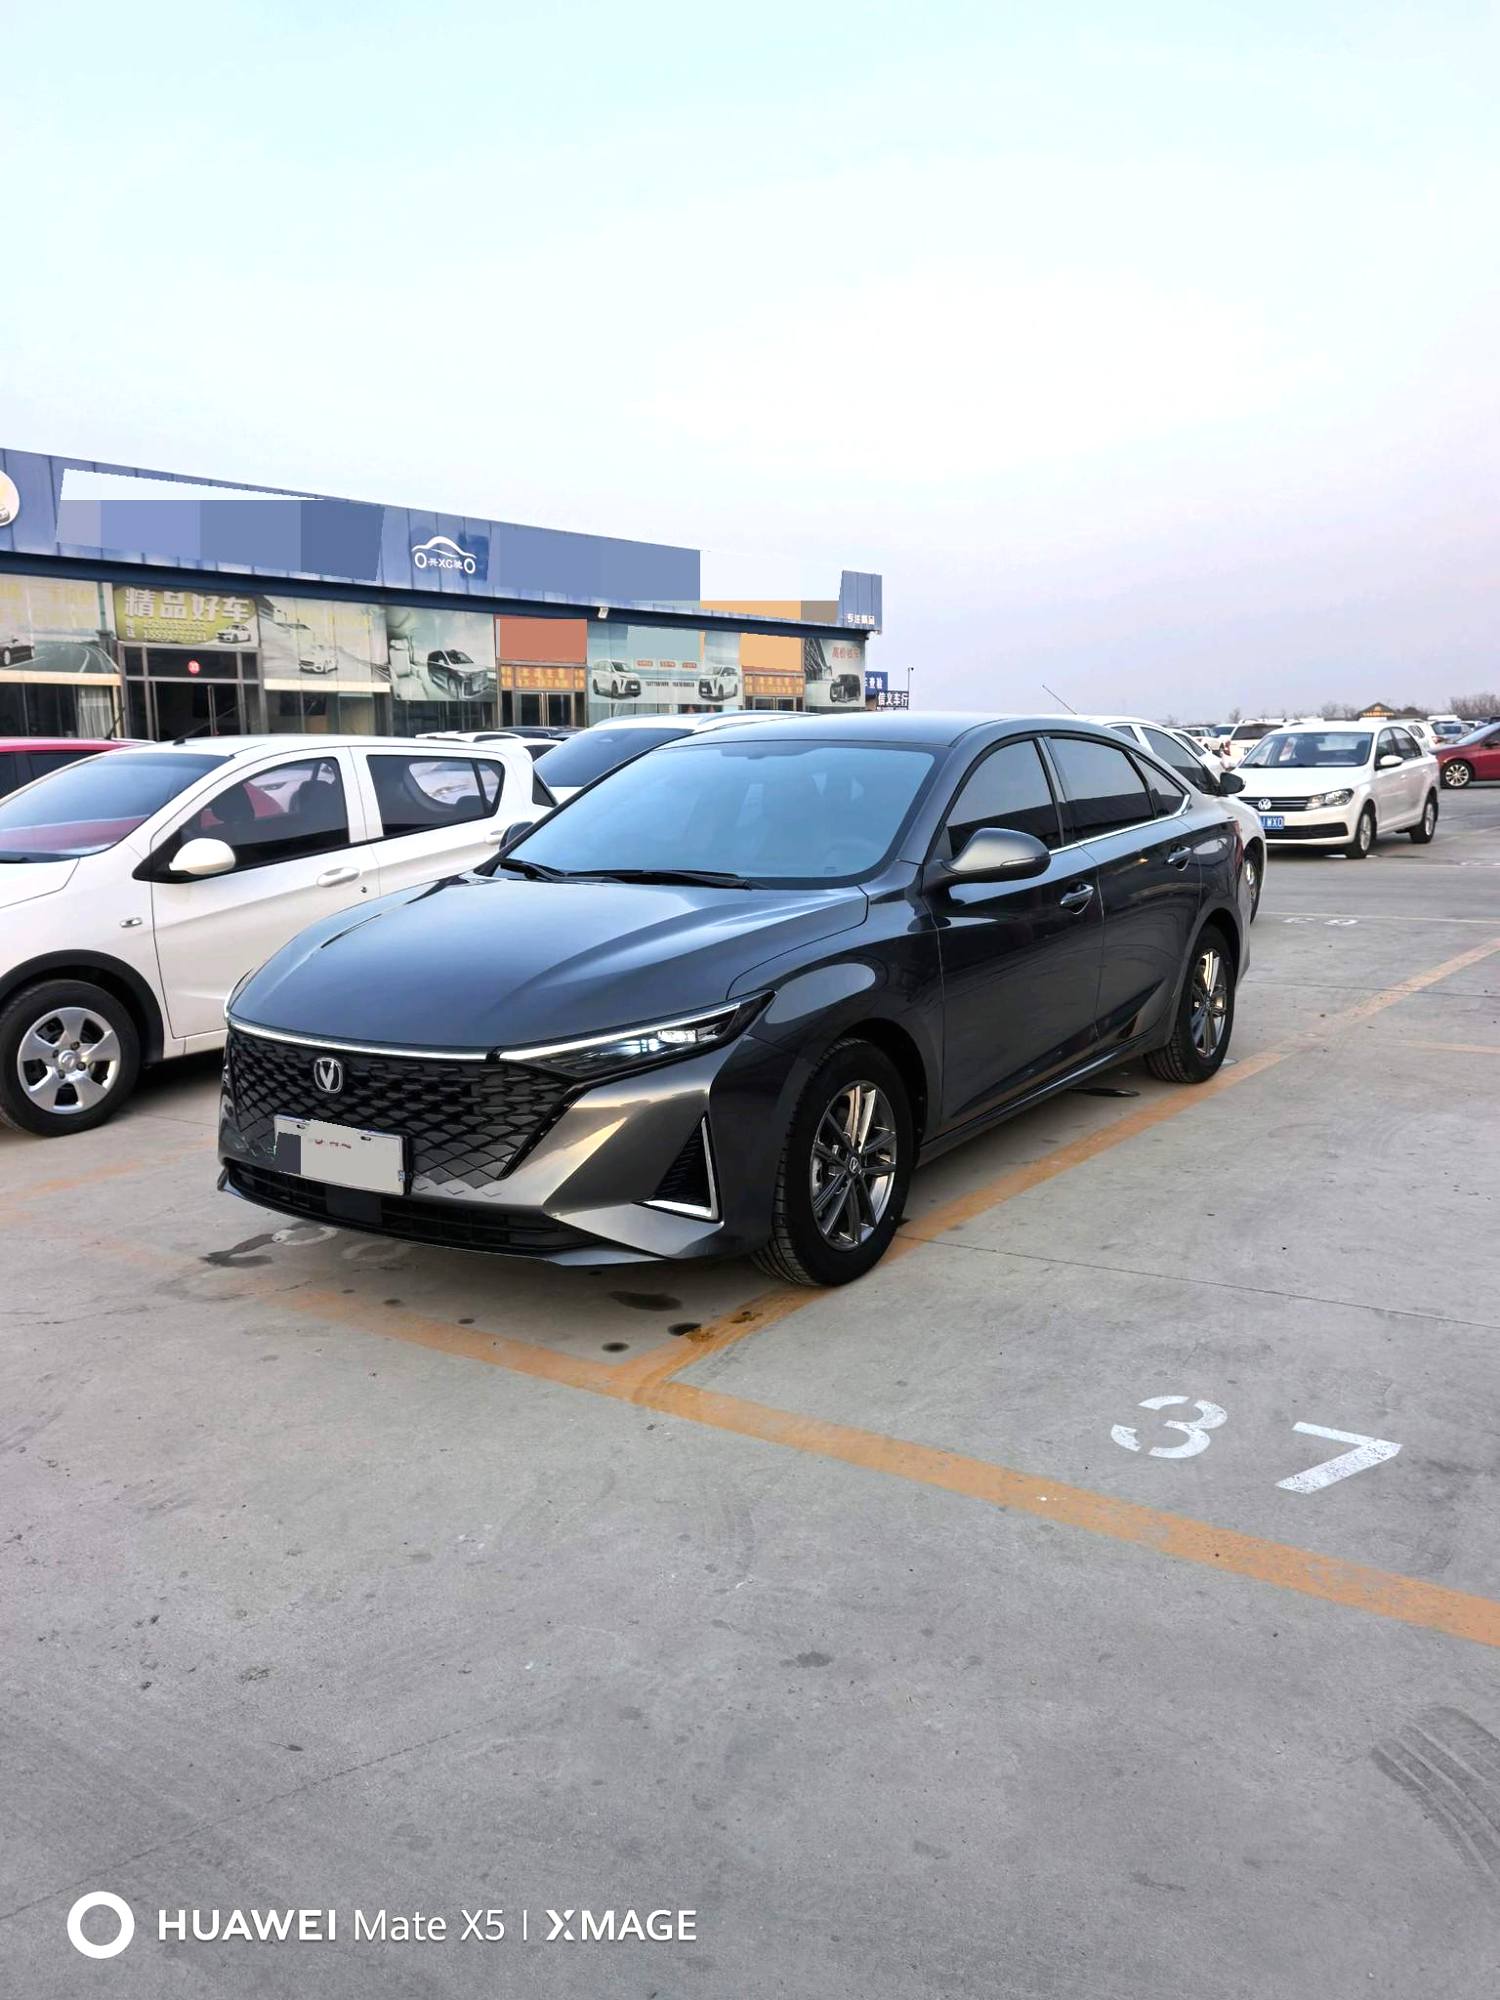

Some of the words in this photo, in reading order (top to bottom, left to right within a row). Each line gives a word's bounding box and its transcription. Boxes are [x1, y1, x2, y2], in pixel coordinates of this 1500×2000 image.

[125, 587, 250, 622] 精品好车
[878, 691, 909, 706] 信义车行
